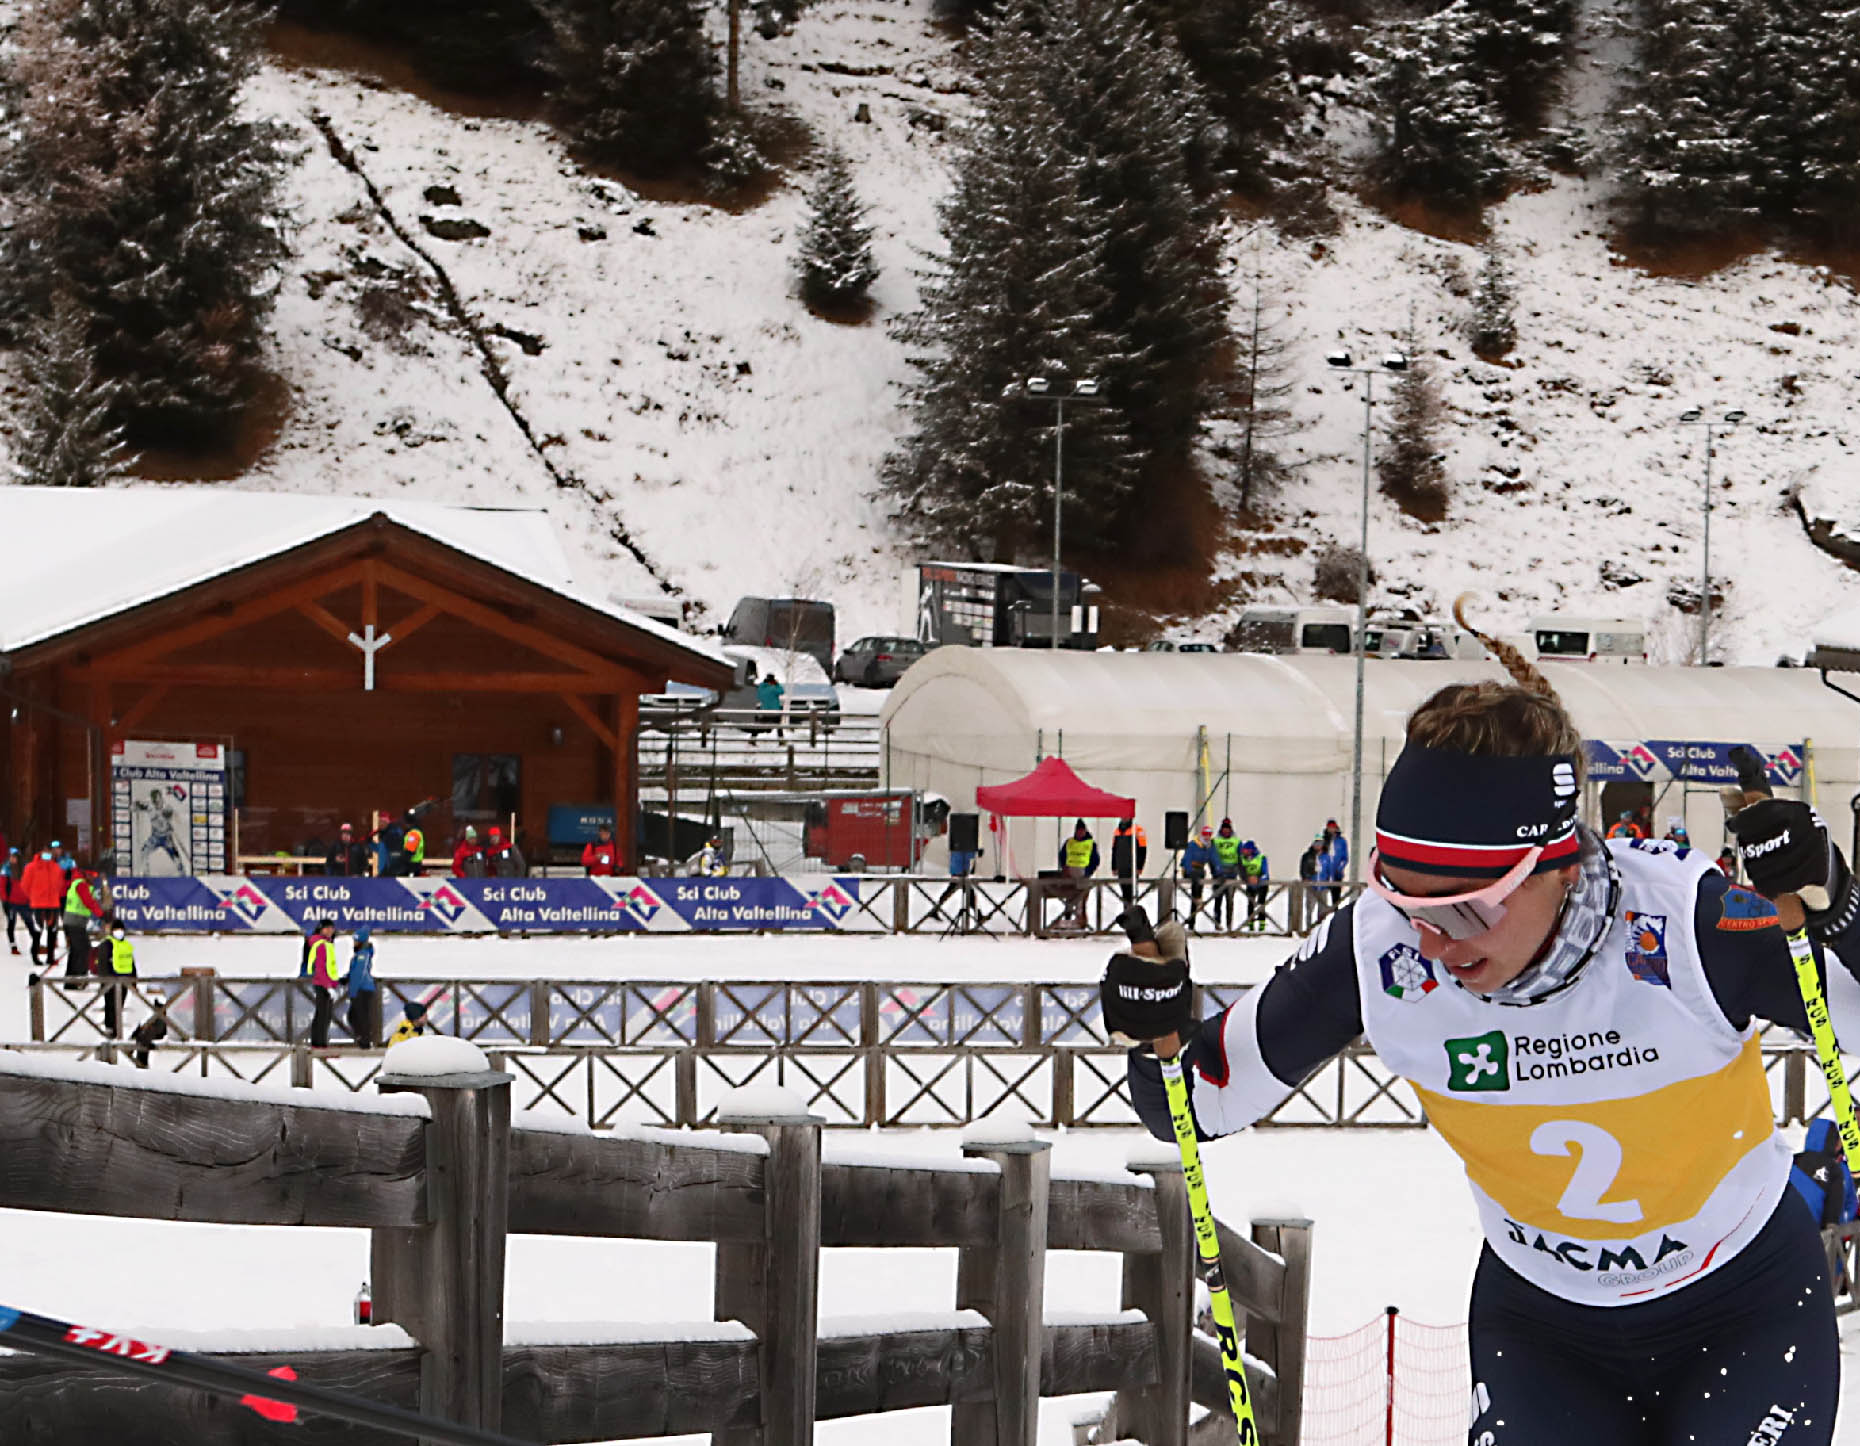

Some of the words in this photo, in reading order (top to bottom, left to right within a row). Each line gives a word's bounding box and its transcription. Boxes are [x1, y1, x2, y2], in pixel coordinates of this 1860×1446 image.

[1667, 747, 1685, 759] Sci
[1688, 747, 1717, 760] Club
[112, 885, 150, 900] Club
[284, 885, 308, 901] Sci
[313, 885, 351, 901] Club
[483, 886, 505, 901] Sci
[510, 886, 547, 901] Club
[677, 886, 700, 901] Sci
[704, 886, 741, 901] Club
[142, 906, 226, 922] Valtellina
[303, 906, 343, 922] Alta
[342, 906, 426, 922] Valtellina
[500, 907, 535, 923] Alta
[537, 907, 621, 923] Valtellina
[694, 906, 729, 922] Alta
[731, 906, 813, 922] Valtellina
[1514, 1029, 1622, 1060] Regione
[1515, 1044, 1660, 1082] Lombardia
[1528, 1119, 1645, 1224] 2
